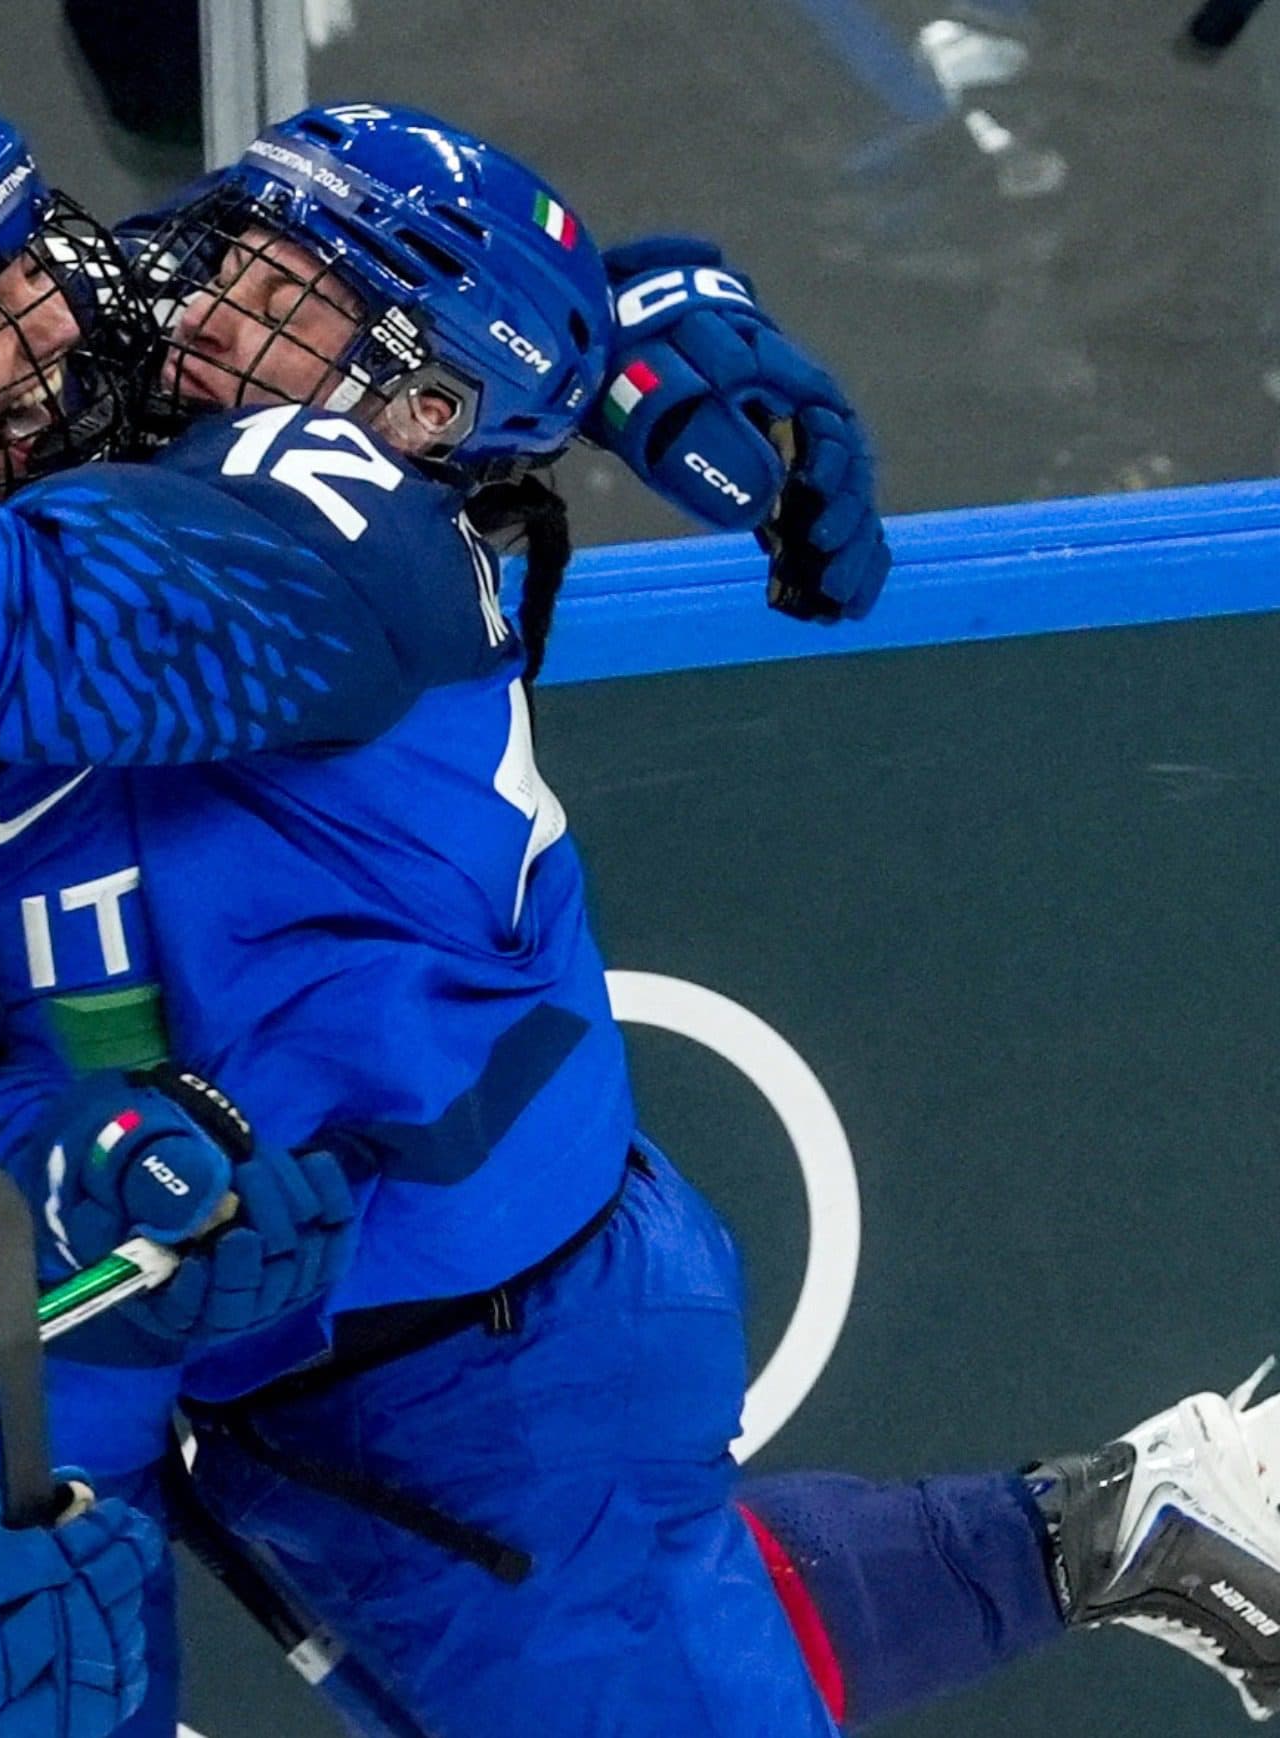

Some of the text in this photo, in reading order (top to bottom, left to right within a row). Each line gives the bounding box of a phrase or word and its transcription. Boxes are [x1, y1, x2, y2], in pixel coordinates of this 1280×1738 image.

[313, 167, 351, 198] 2026
[617, 268, 756, 327] CC
[371, 325, 421, 371] CCM
[488, 319, 553, 375] CCM
[222, 405, 404, 542] 12
[683, 452, 752, 506] CCM
[21, 866, 141, 989] IT
[141, 1154, 191, 1197] CCM
